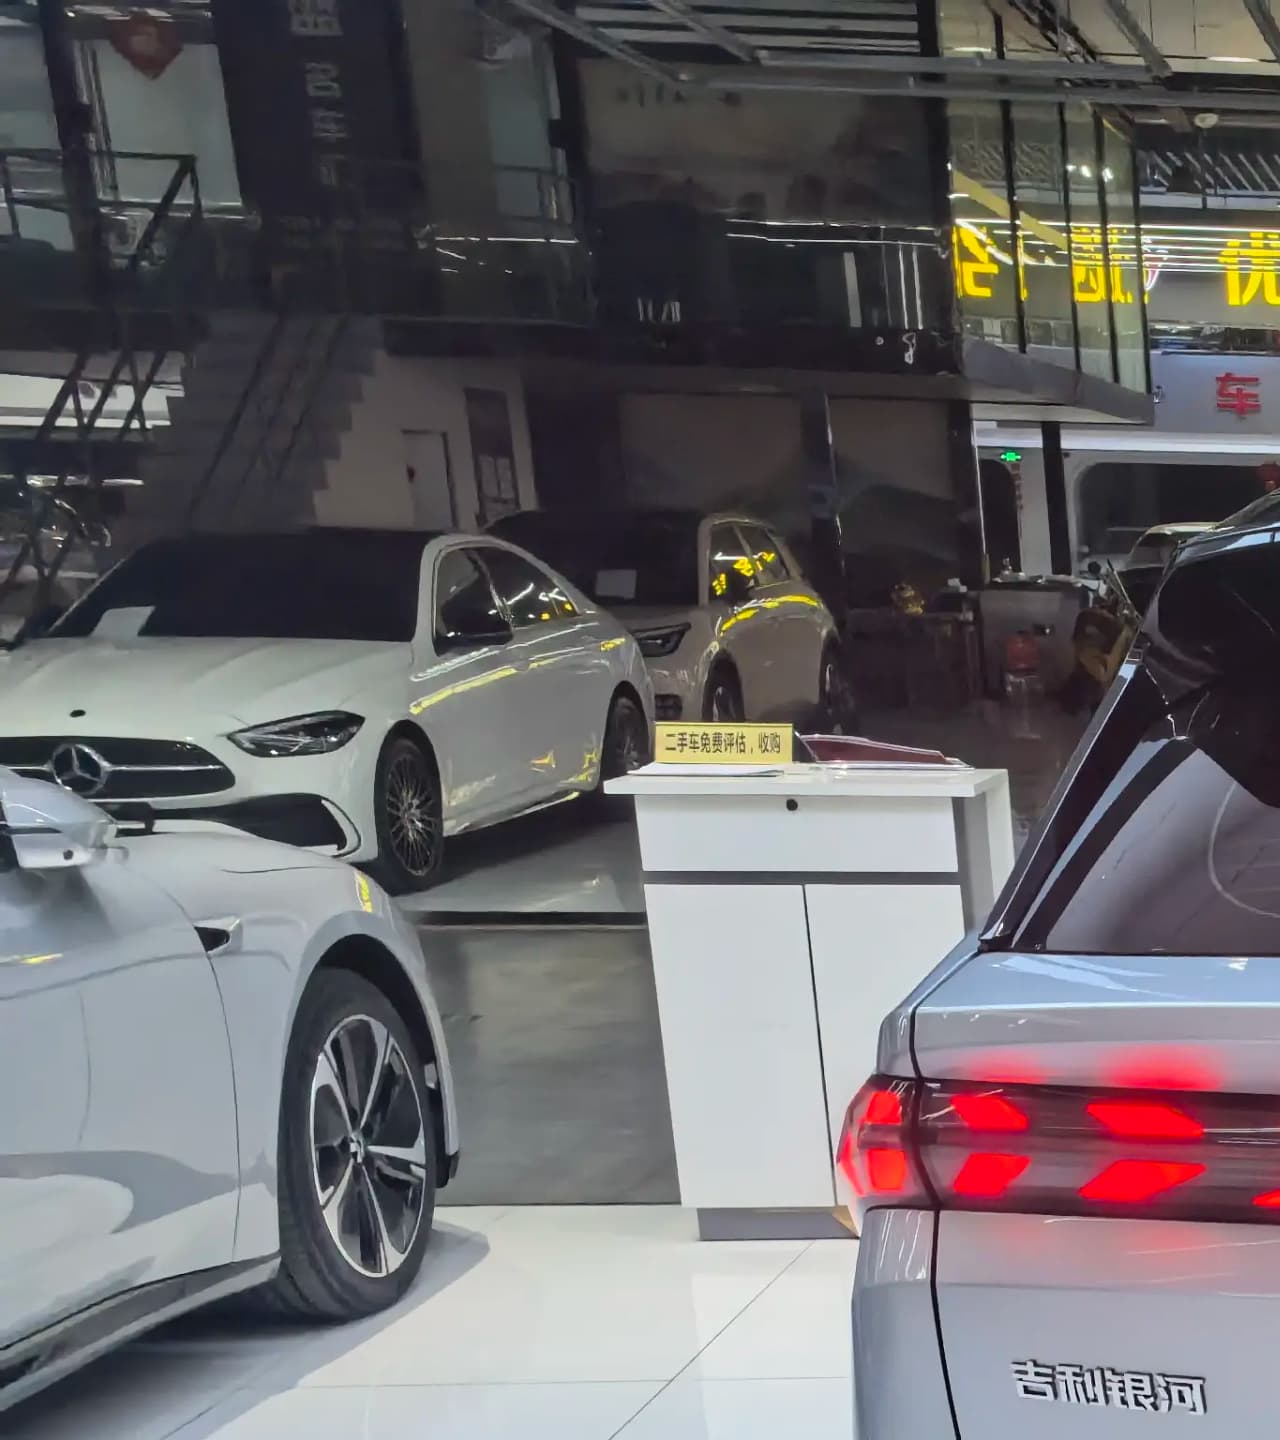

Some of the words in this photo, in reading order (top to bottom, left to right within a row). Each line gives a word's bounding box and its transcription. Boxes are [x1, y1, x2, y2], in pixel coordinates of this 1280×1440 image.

[665, 732, 781, 754] 二手车免费评估，收购
[1010, 1359, 1208, 1417] 吉利银河
